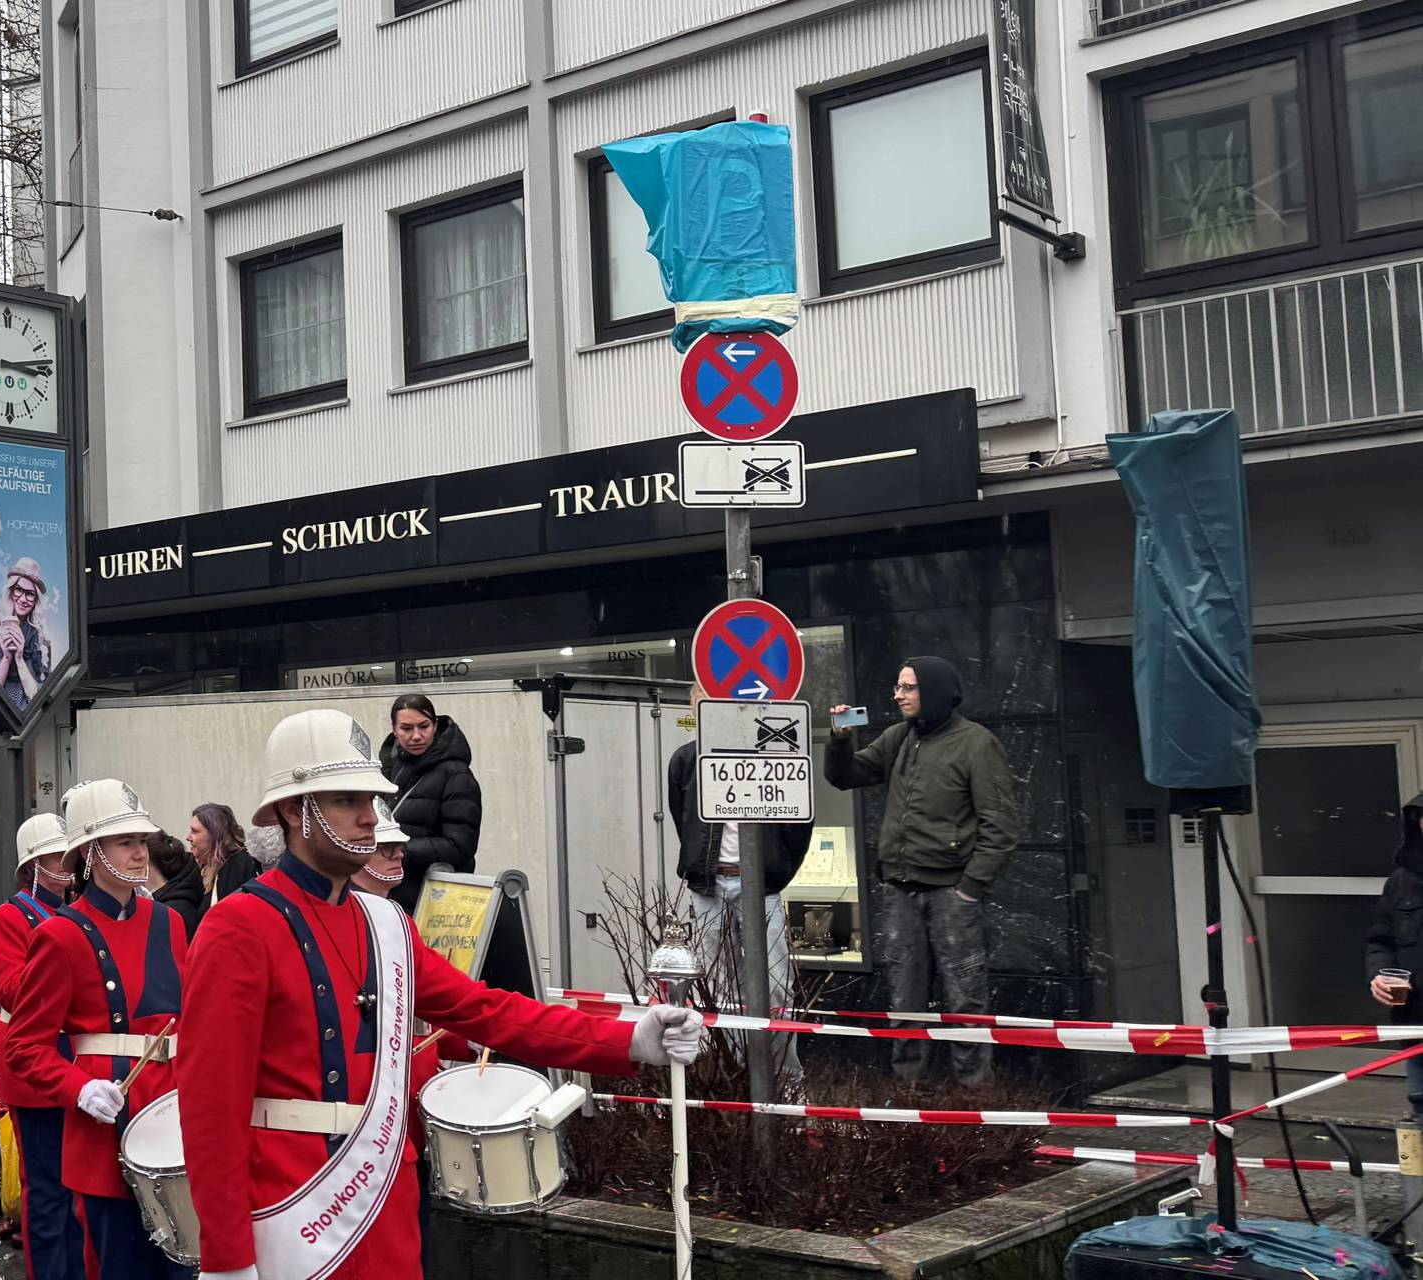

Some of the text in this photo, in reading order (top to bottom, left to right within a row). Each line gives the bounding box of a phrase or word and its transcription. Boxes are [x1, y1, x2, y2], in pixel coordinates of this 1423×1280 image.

[17, 455, 27, 465] SIE
[29, 457, 58, 469] UNSERE
[7, 519, 63, 536] HOFGARTEN
[99, 472, 678, 580] UHREN SCHMUCK TRAUR
[607, 649, 646, 664] BOSS
[303, 661, 469, 689] PANDORA SEIKO
[710, 762, 807, 782] 16.02.2026
[725, 785, 736, 803] 6
[757, 784, 785, 802] 18h
[715, 804, 799, 816] Rosenmontagszug
[300, 1160, 375, 1244] Showkorps
[373, 1096, 398, 1155] Juliana
[389, 961, 403, 1069] 's-Gravendeel
